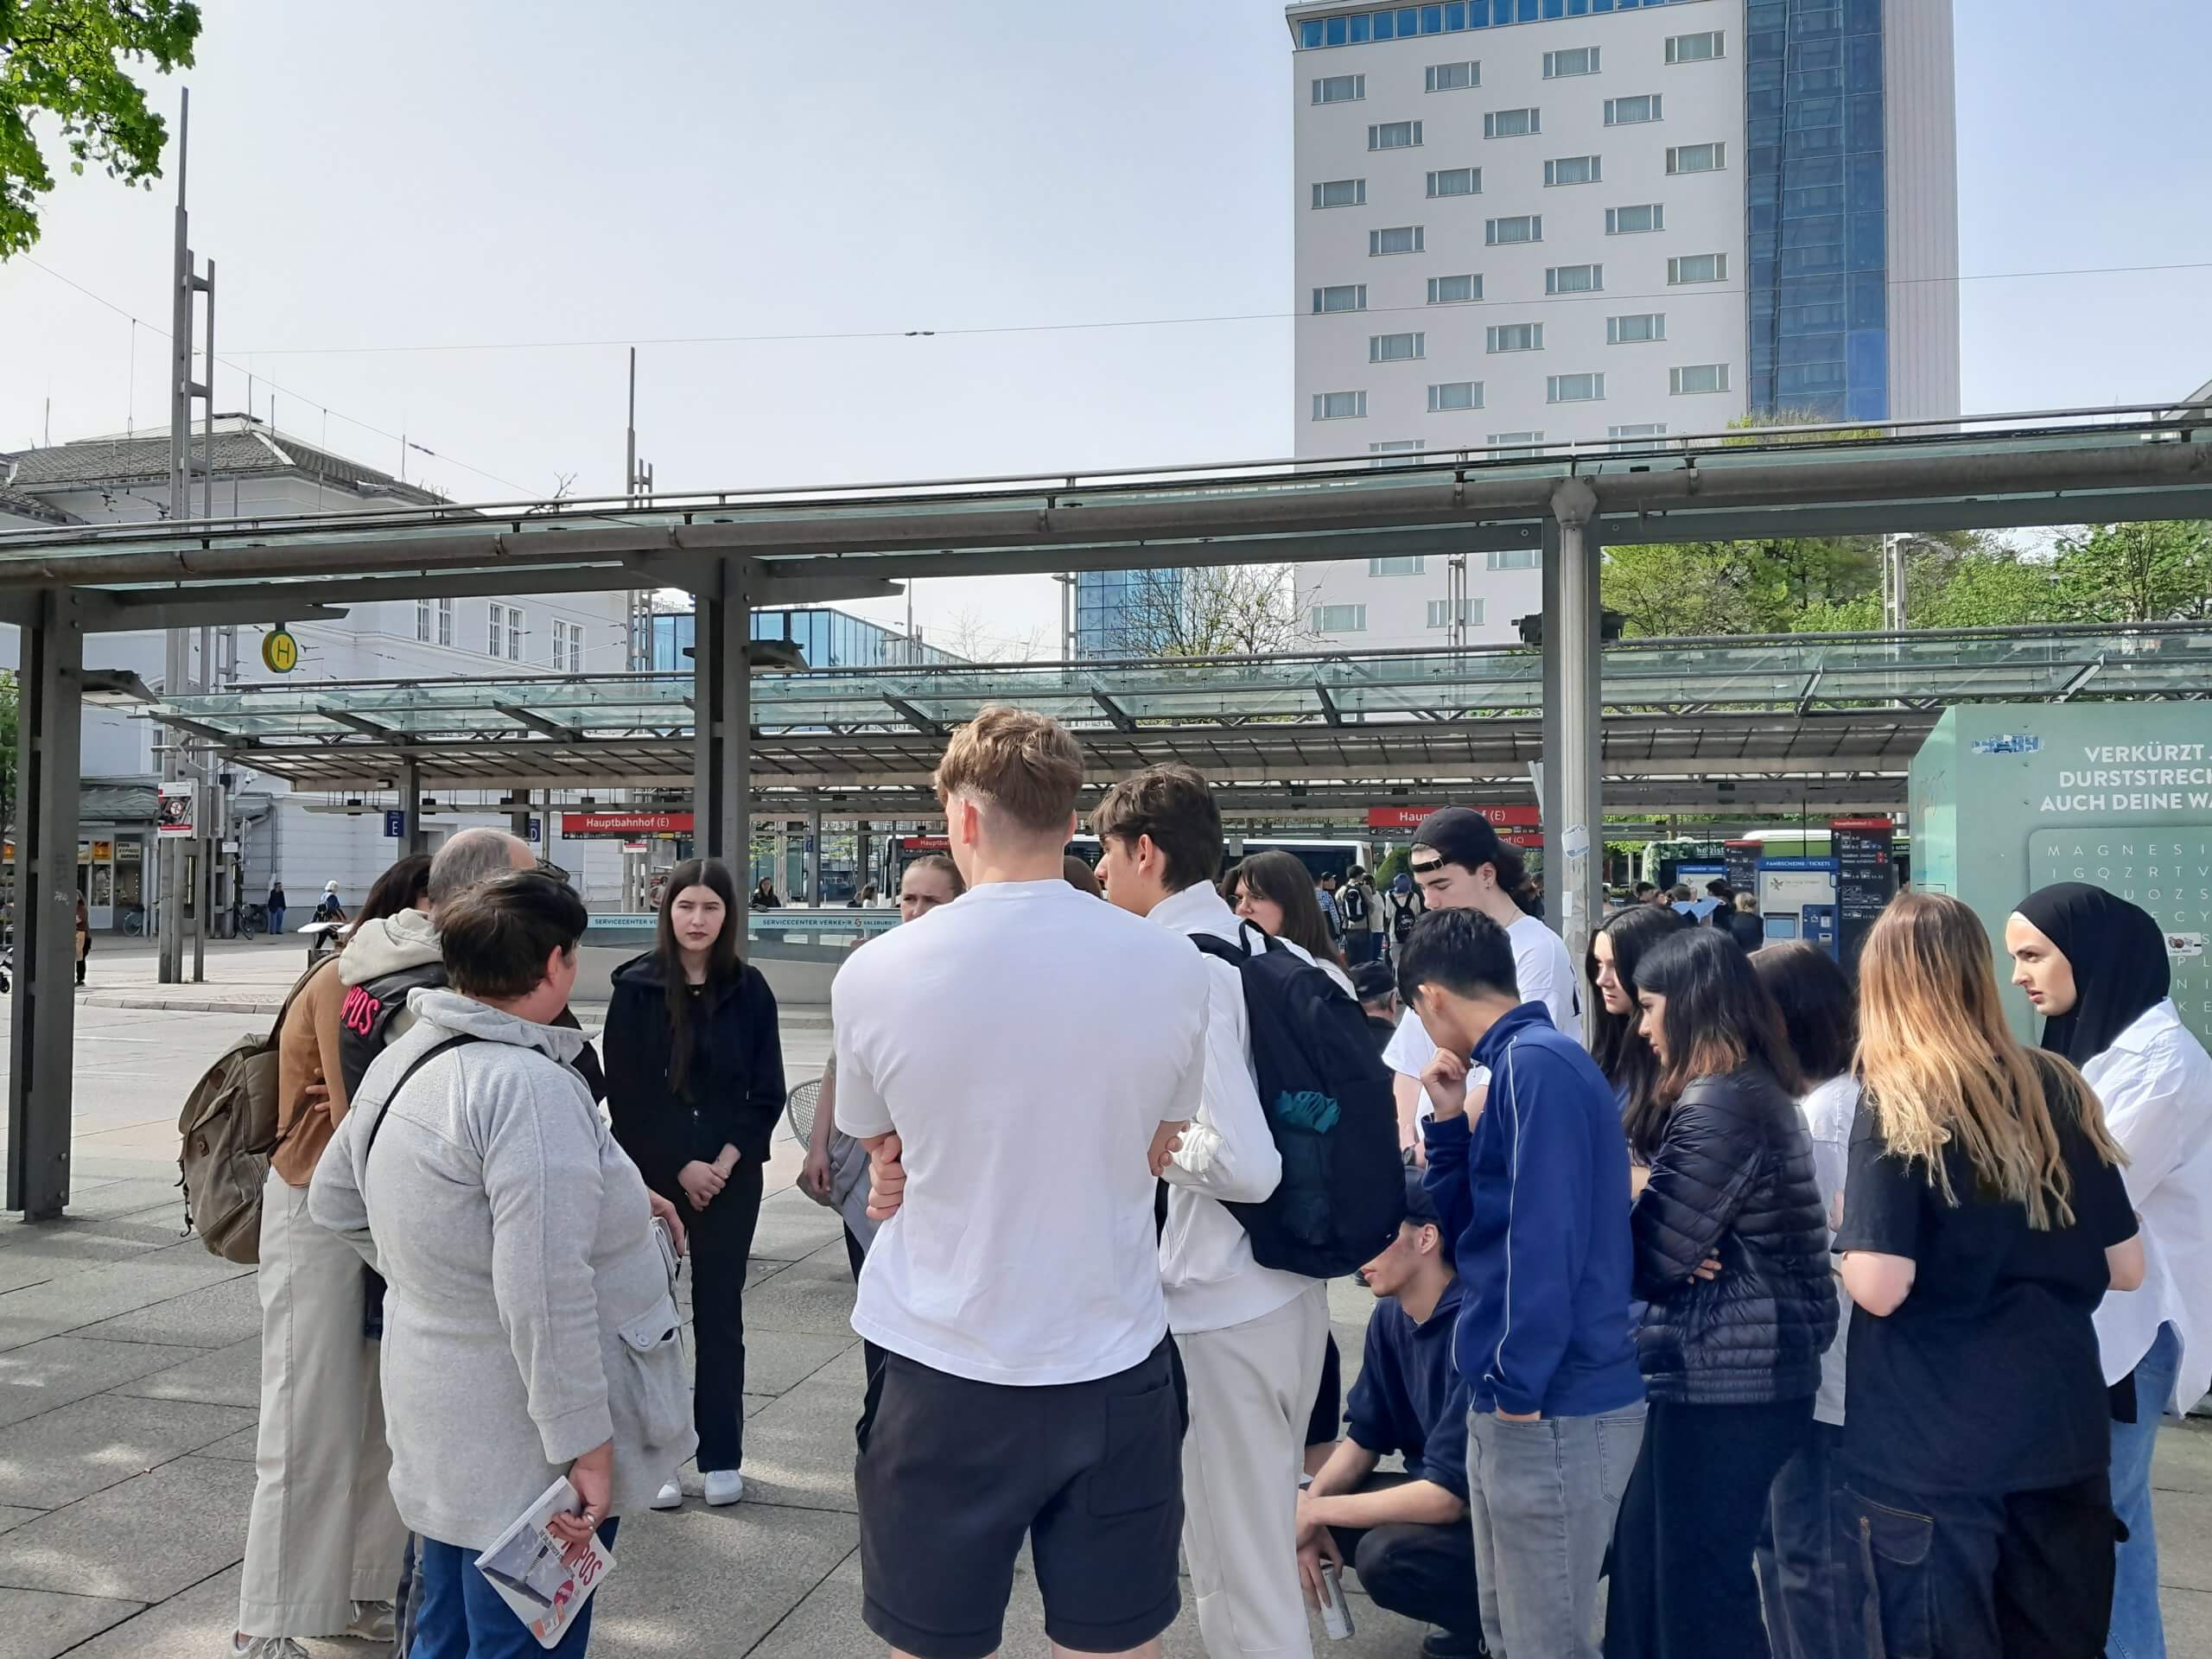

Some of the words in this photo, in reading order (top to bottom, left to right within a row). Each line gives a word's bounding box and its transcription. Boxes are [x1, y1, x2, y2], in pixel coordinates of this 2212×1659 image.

[276, 639, 290, 664] H
[2083, 741, 2205, 763] VERKÜRZT
[2040, 794, 2106, 812] AUCH
[2113, 792, 2183, 810] DEINE
[586, 817, 655, 830] Hauptbahnhof
[657, 817, 670, 828] (E)
[1490, 810, 1507, 822] (E)
[391, 821, 399, 836] E
